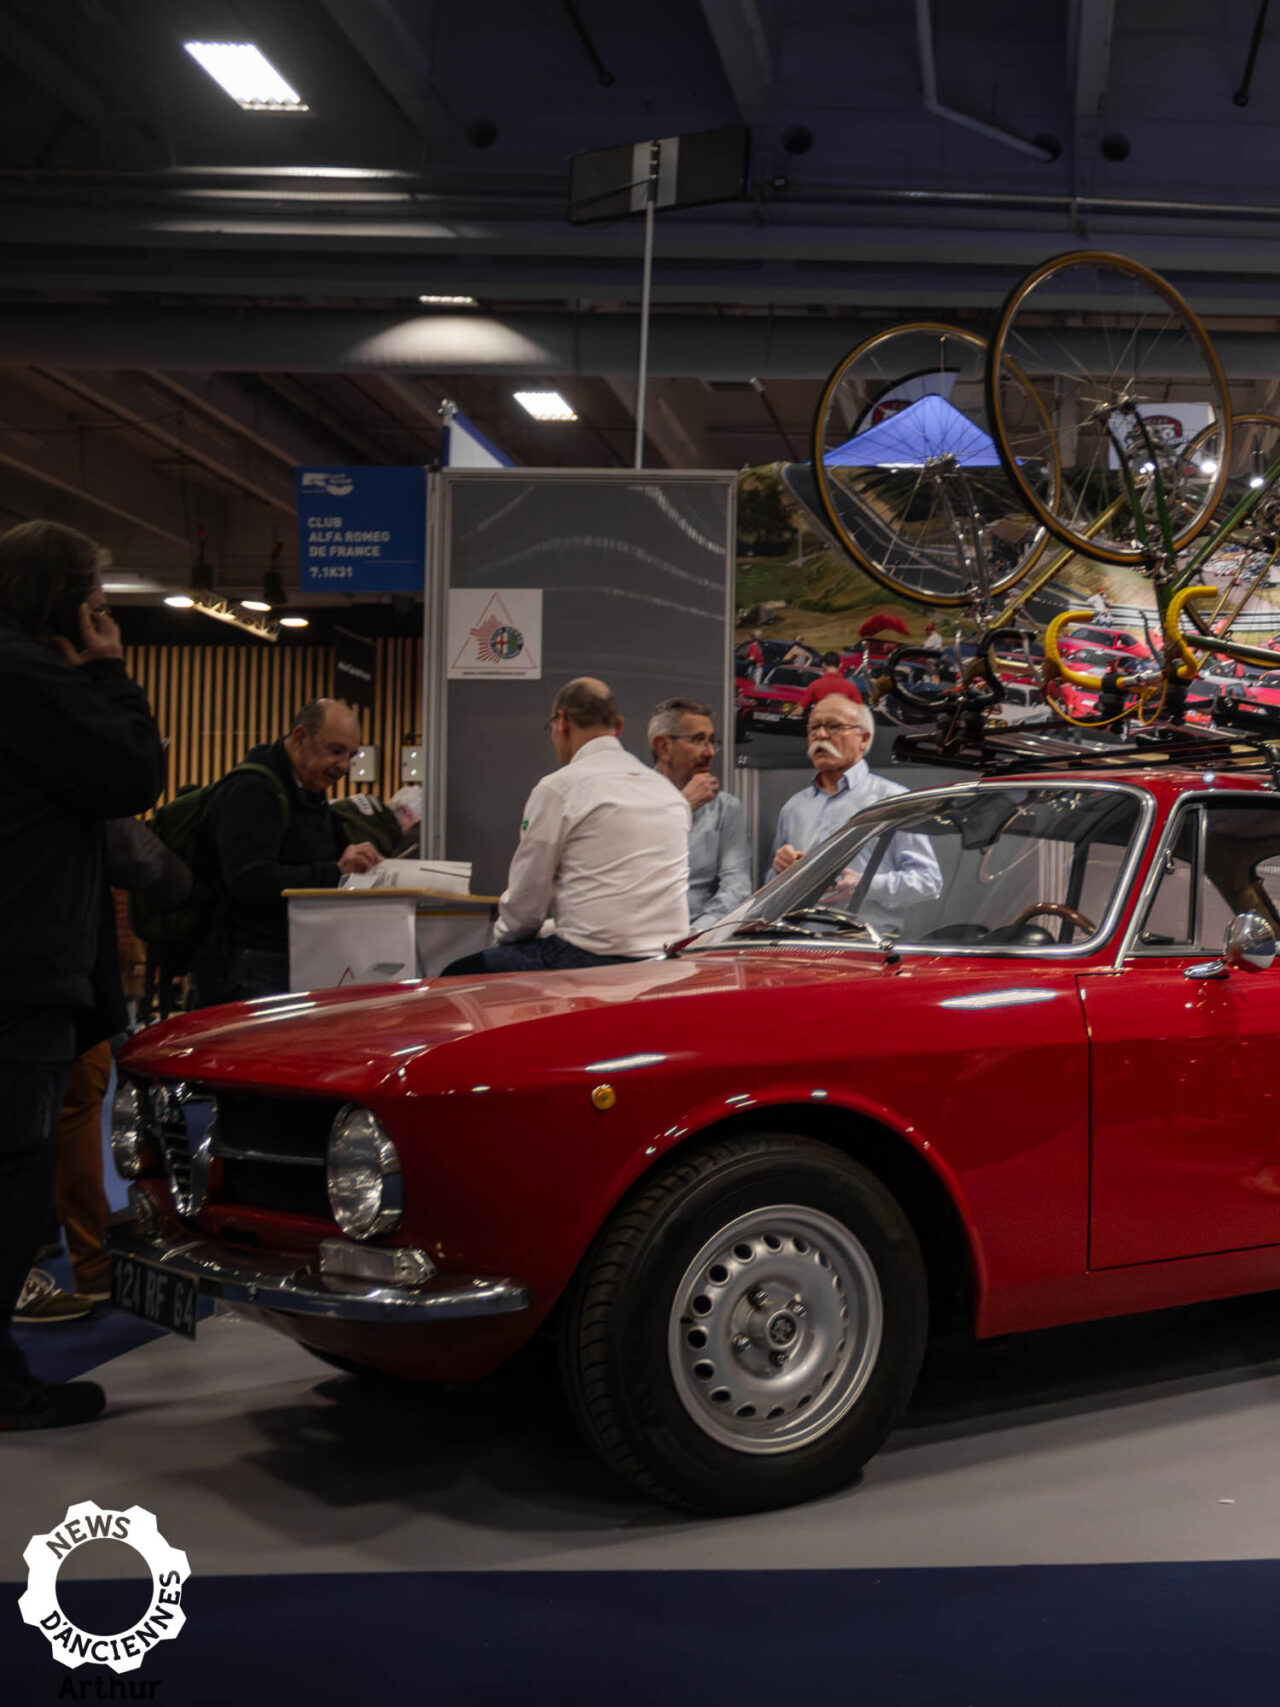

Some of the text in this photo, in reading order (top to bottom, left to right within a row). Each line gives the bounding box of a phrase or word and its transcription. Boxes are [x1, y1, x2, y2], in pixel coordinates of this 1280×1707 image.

[308, 517, 343, 528] CLUB
[308, 531, 391, 542] ALFA ROMEO
[309, 546, 381, 557] DE FRANCE
[145, 1269, 169, 1320] RF
